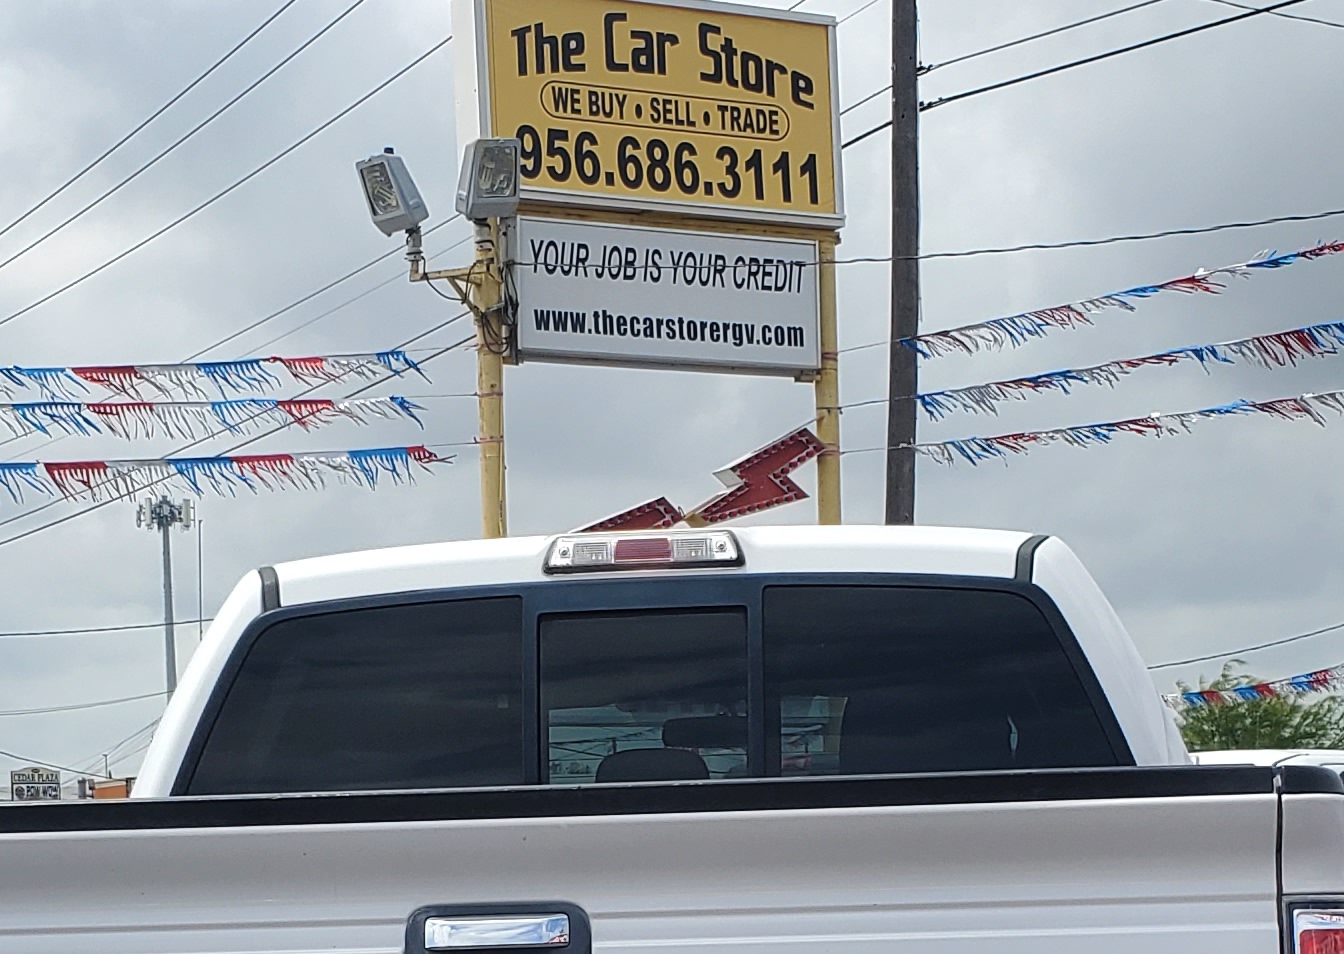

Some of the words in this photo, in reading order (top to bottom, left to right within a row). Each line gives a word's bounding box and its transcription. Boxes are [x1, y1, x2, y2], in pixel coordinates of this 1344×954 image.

[511, 22, 586, 77] The
[603, 12, 680, 76] Car
[698, 22, 816, 110] Store
[551, 86, 582, 115] WE
[588, 90, 627, 120] BUY
[649, 97, 696, 127] SELL
[717, 104, 780, 135] TRADE
[516, 125, 819, 205] 956.686.3111
[530, 239, 590, 278] YOUR
[594, 244, 637, 281] JOB
[643, 249, 663, 283] IS
[669, 251, 726, 289] YOUR
[732, 256, 806, 294] CREDIT
[533, 307, 805, 348] www.thecarstorergv.com
[37, 773, 59, 782] PLAZA
